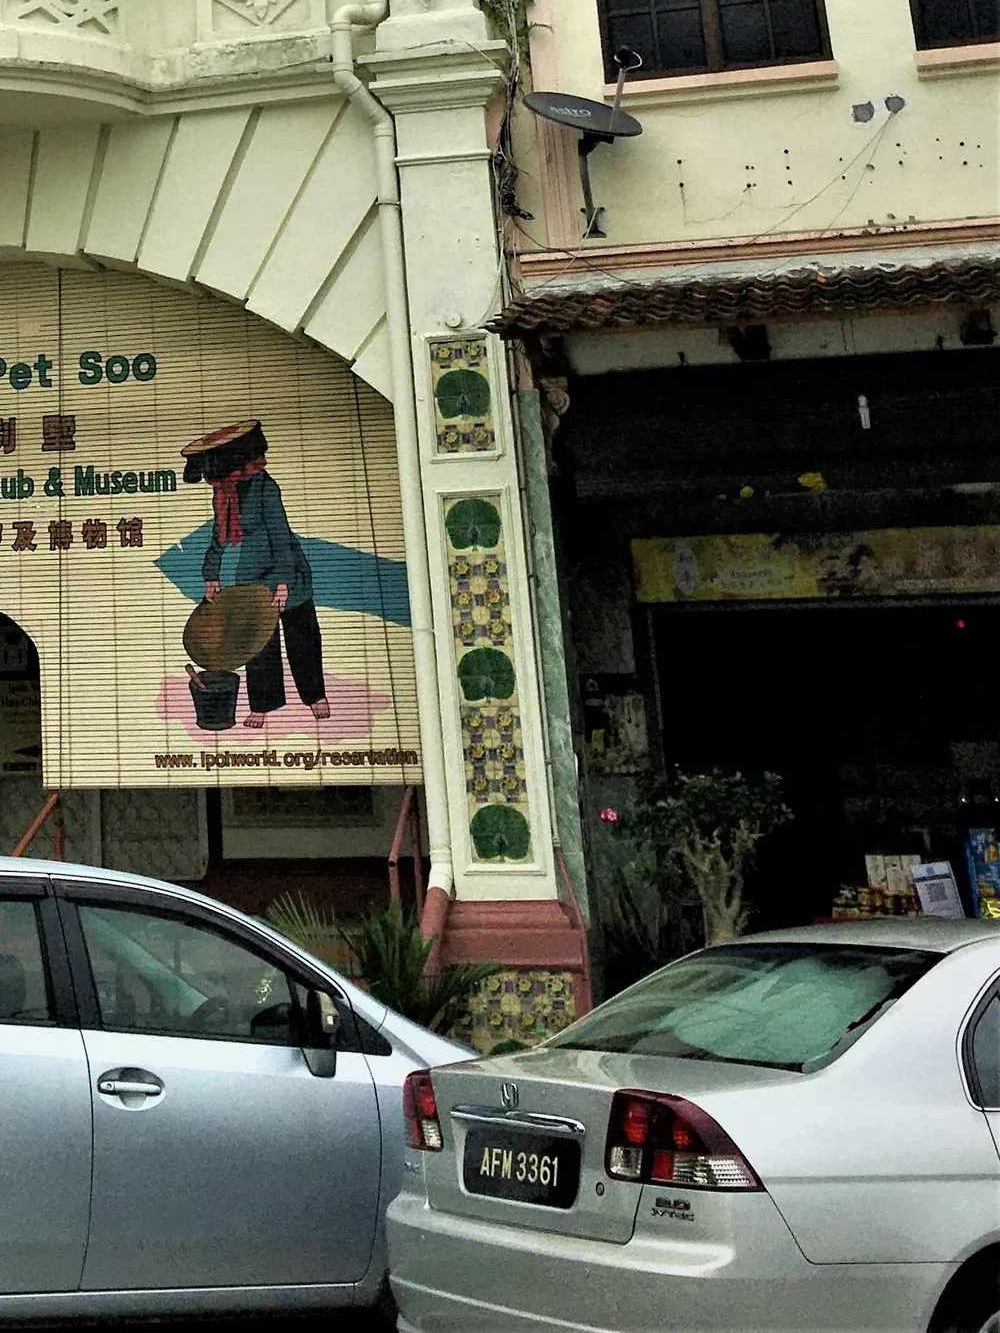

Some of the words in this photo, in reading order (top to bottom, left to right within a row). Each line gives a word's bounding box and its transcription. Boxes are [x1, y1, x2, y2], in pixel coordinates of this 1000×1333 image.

[549, 106, 592, 118] astro
[78, 350, 157, 385] Soo
[43, 466, 66, 497] &
[74, 465, 177, 497] Museum
[480, 1147, 513, 1179] AFM
[515, 1152, 559, 1187] 3361
